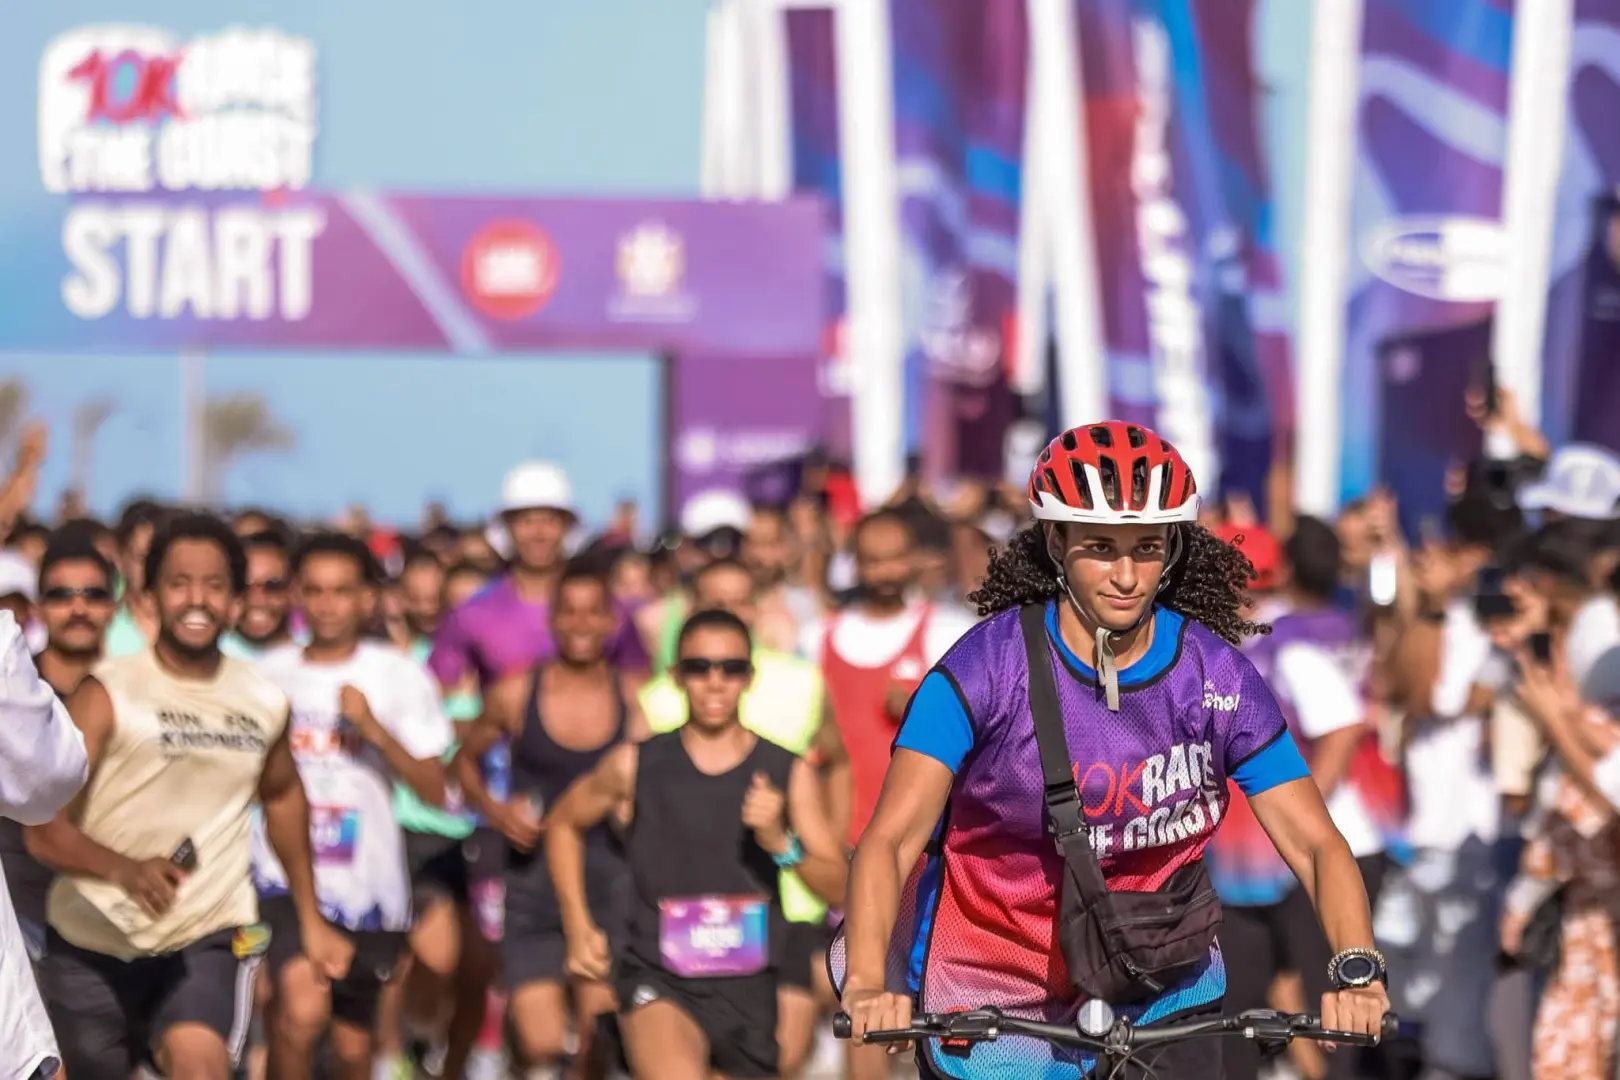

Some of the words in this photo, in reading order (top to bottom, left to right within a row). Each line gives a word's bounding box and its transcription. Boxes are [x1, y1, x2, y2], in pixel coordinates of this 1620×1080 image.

[66, 48, 188, 126] 10K
[61, 206, 328, 321] START
[1141, 741, 1217, 808] RACE
[1123, 789, 1221, 852] COAST
